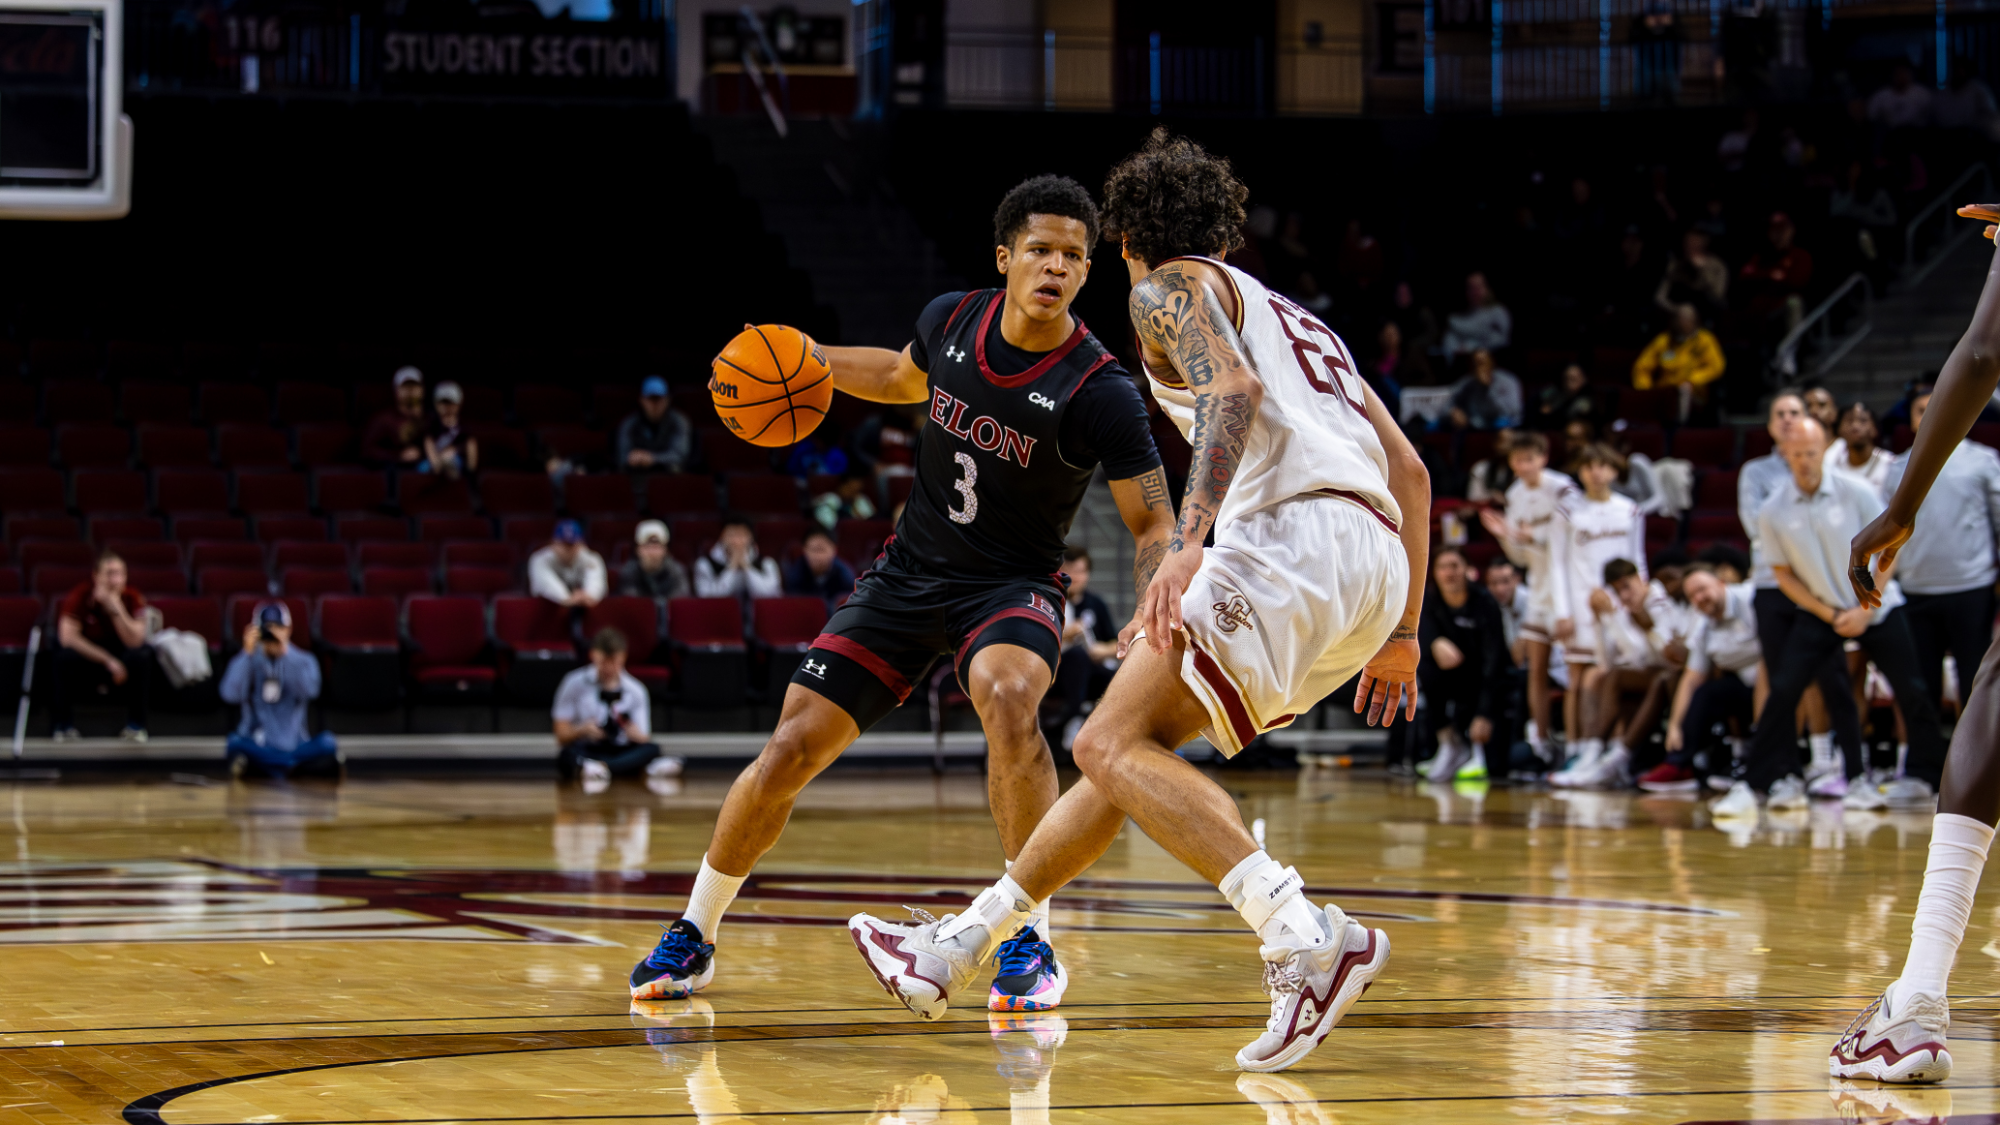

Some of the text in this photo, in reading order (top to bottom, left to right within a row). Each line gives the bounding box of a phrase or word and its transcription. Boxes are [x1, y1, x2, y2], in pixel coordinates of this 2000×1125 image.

[225, 15, 283, 51] 116
[383, 29, 661, 79] STUDENT SECTION
[711, 371, 739, 400] lson
[1028, 392, 1055, 411] CAA
[930, 385, 1038, 468] ELON
[948, 451, 978, 525] 3
[1027, 591, 1055, 622] E
